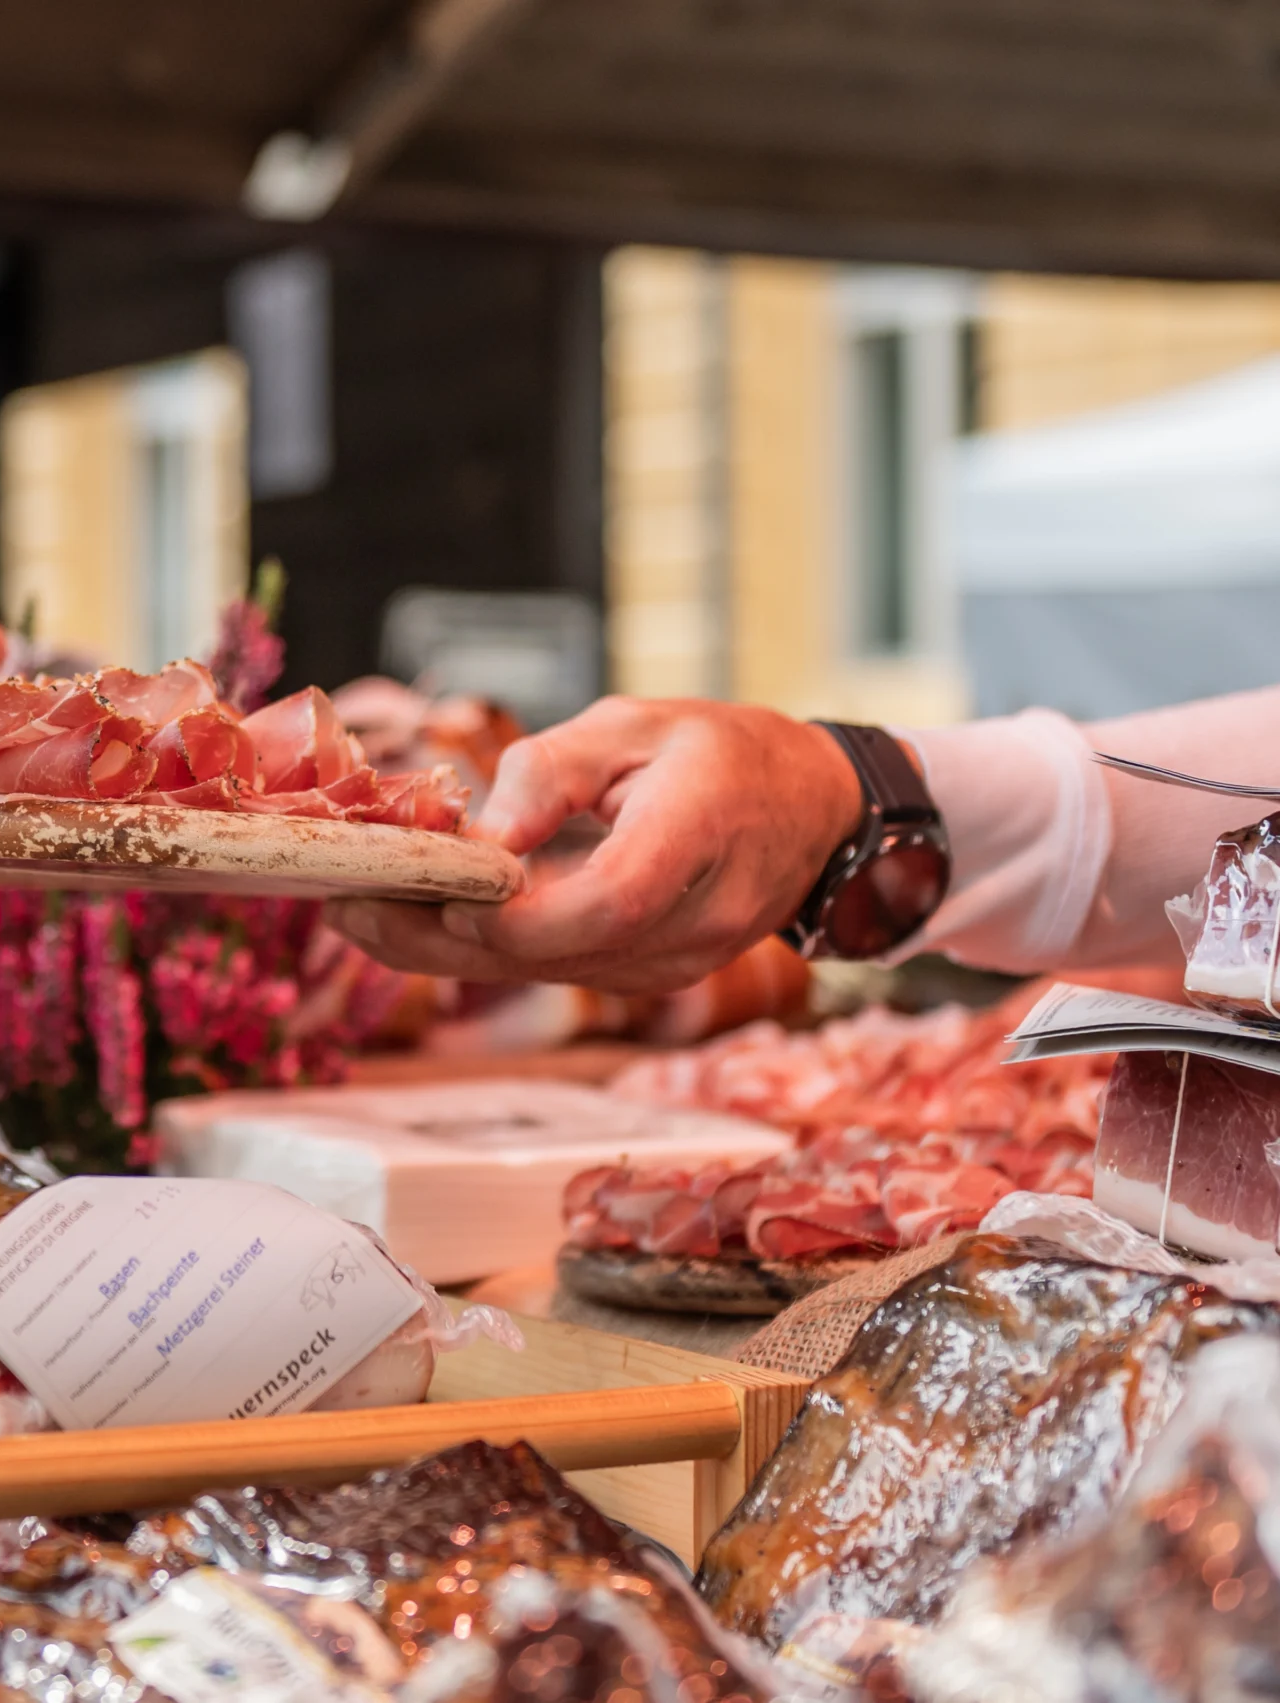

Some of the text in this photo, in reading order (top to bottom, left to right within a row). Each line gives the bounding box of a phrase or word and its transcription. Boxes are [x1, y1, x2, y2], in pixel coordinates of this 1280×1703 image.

[42, 1233, 57, 1248] DI
[53, 1199, 94, 1237] ORIGINE
[127, 1249, 201, 1329] Bachpeinte
[156, 1281, 225, 1358] Metzgerei
[219, 1236, 267, 1289] Steiner
